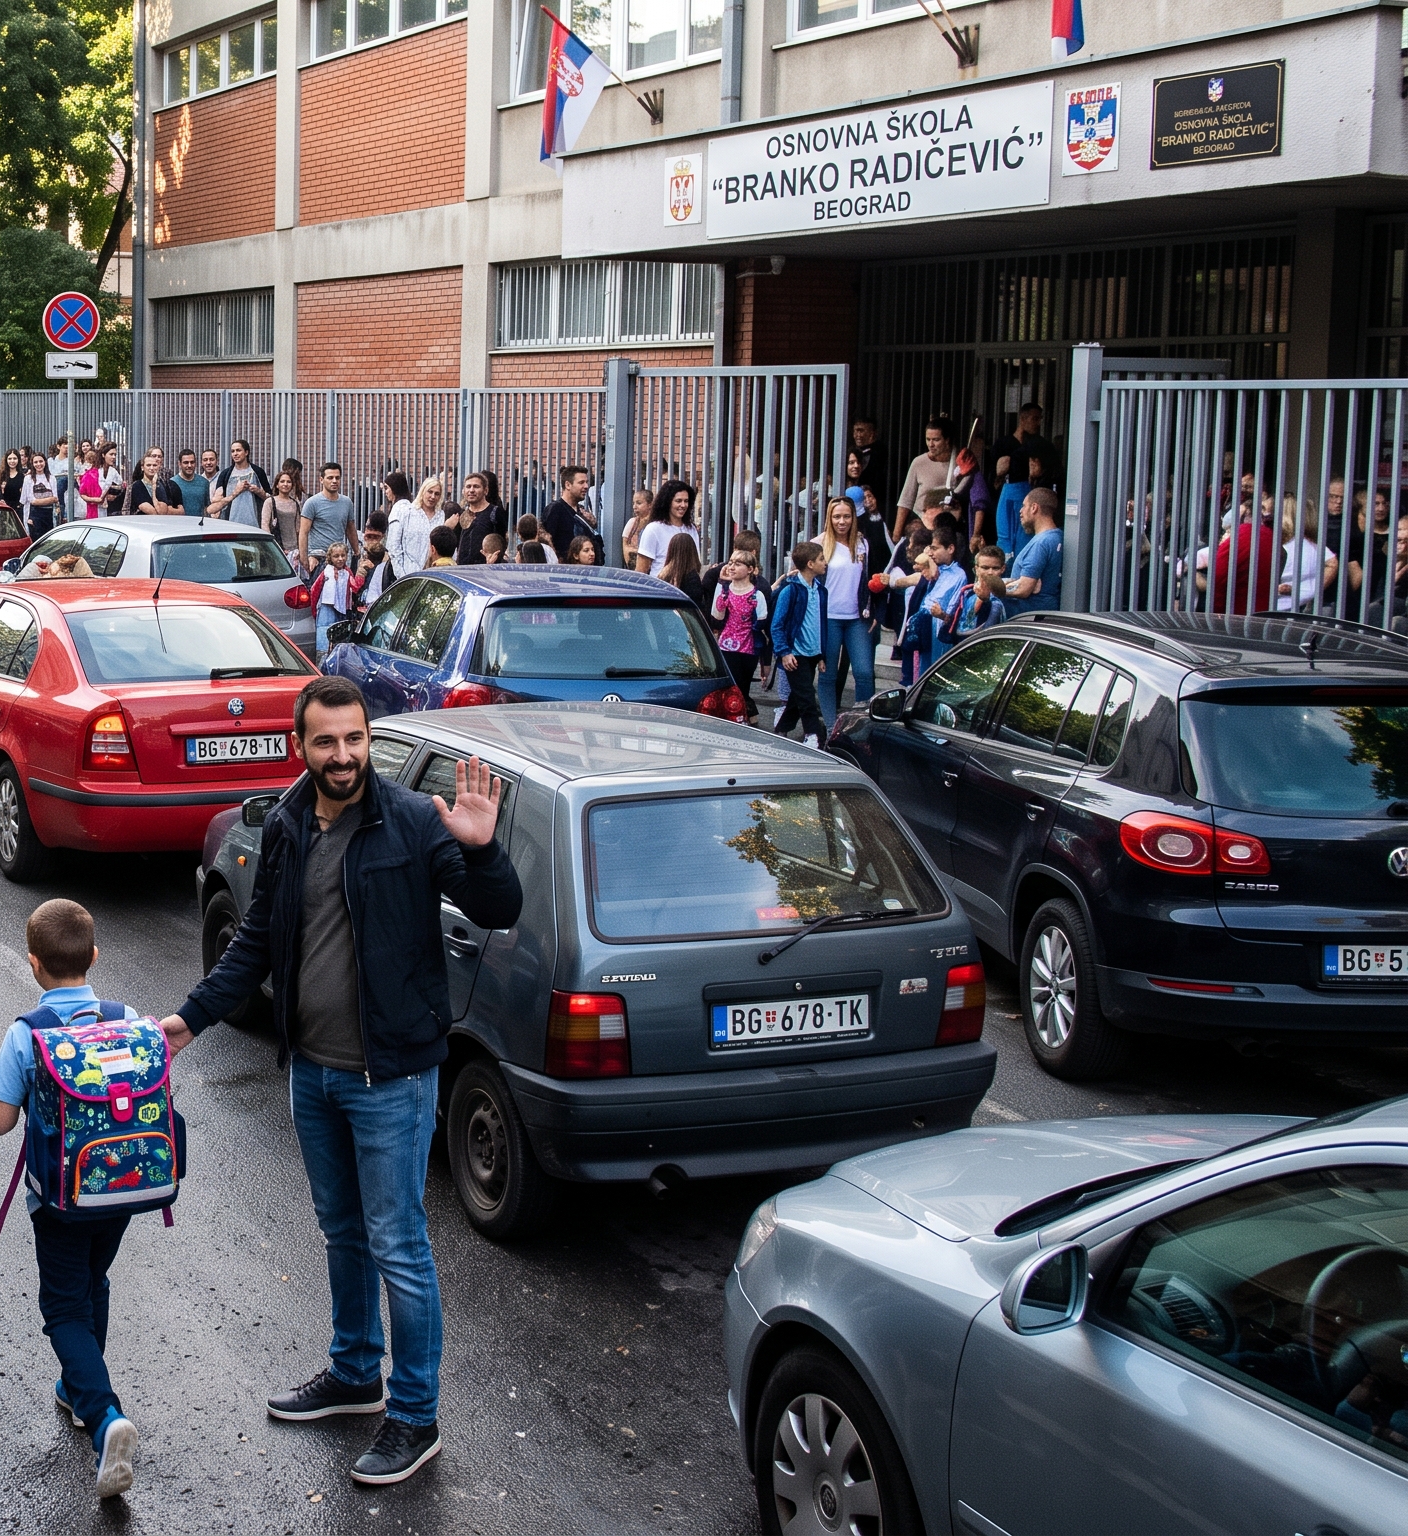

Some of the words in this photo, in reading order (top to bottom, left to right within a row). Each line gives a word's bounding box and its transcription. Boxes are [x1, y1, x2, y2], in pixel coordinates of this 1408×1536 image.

[766, 120, 878, 159] OSNOVNA
[886, 104, 973, 141] ŠKOLA
[813, 191, 911, 221] BEOGRAD
[198, 740, 218, 758] BG
[1342, 948, 1371, 972] BG
[731, 1007, 762, 1036] BG
